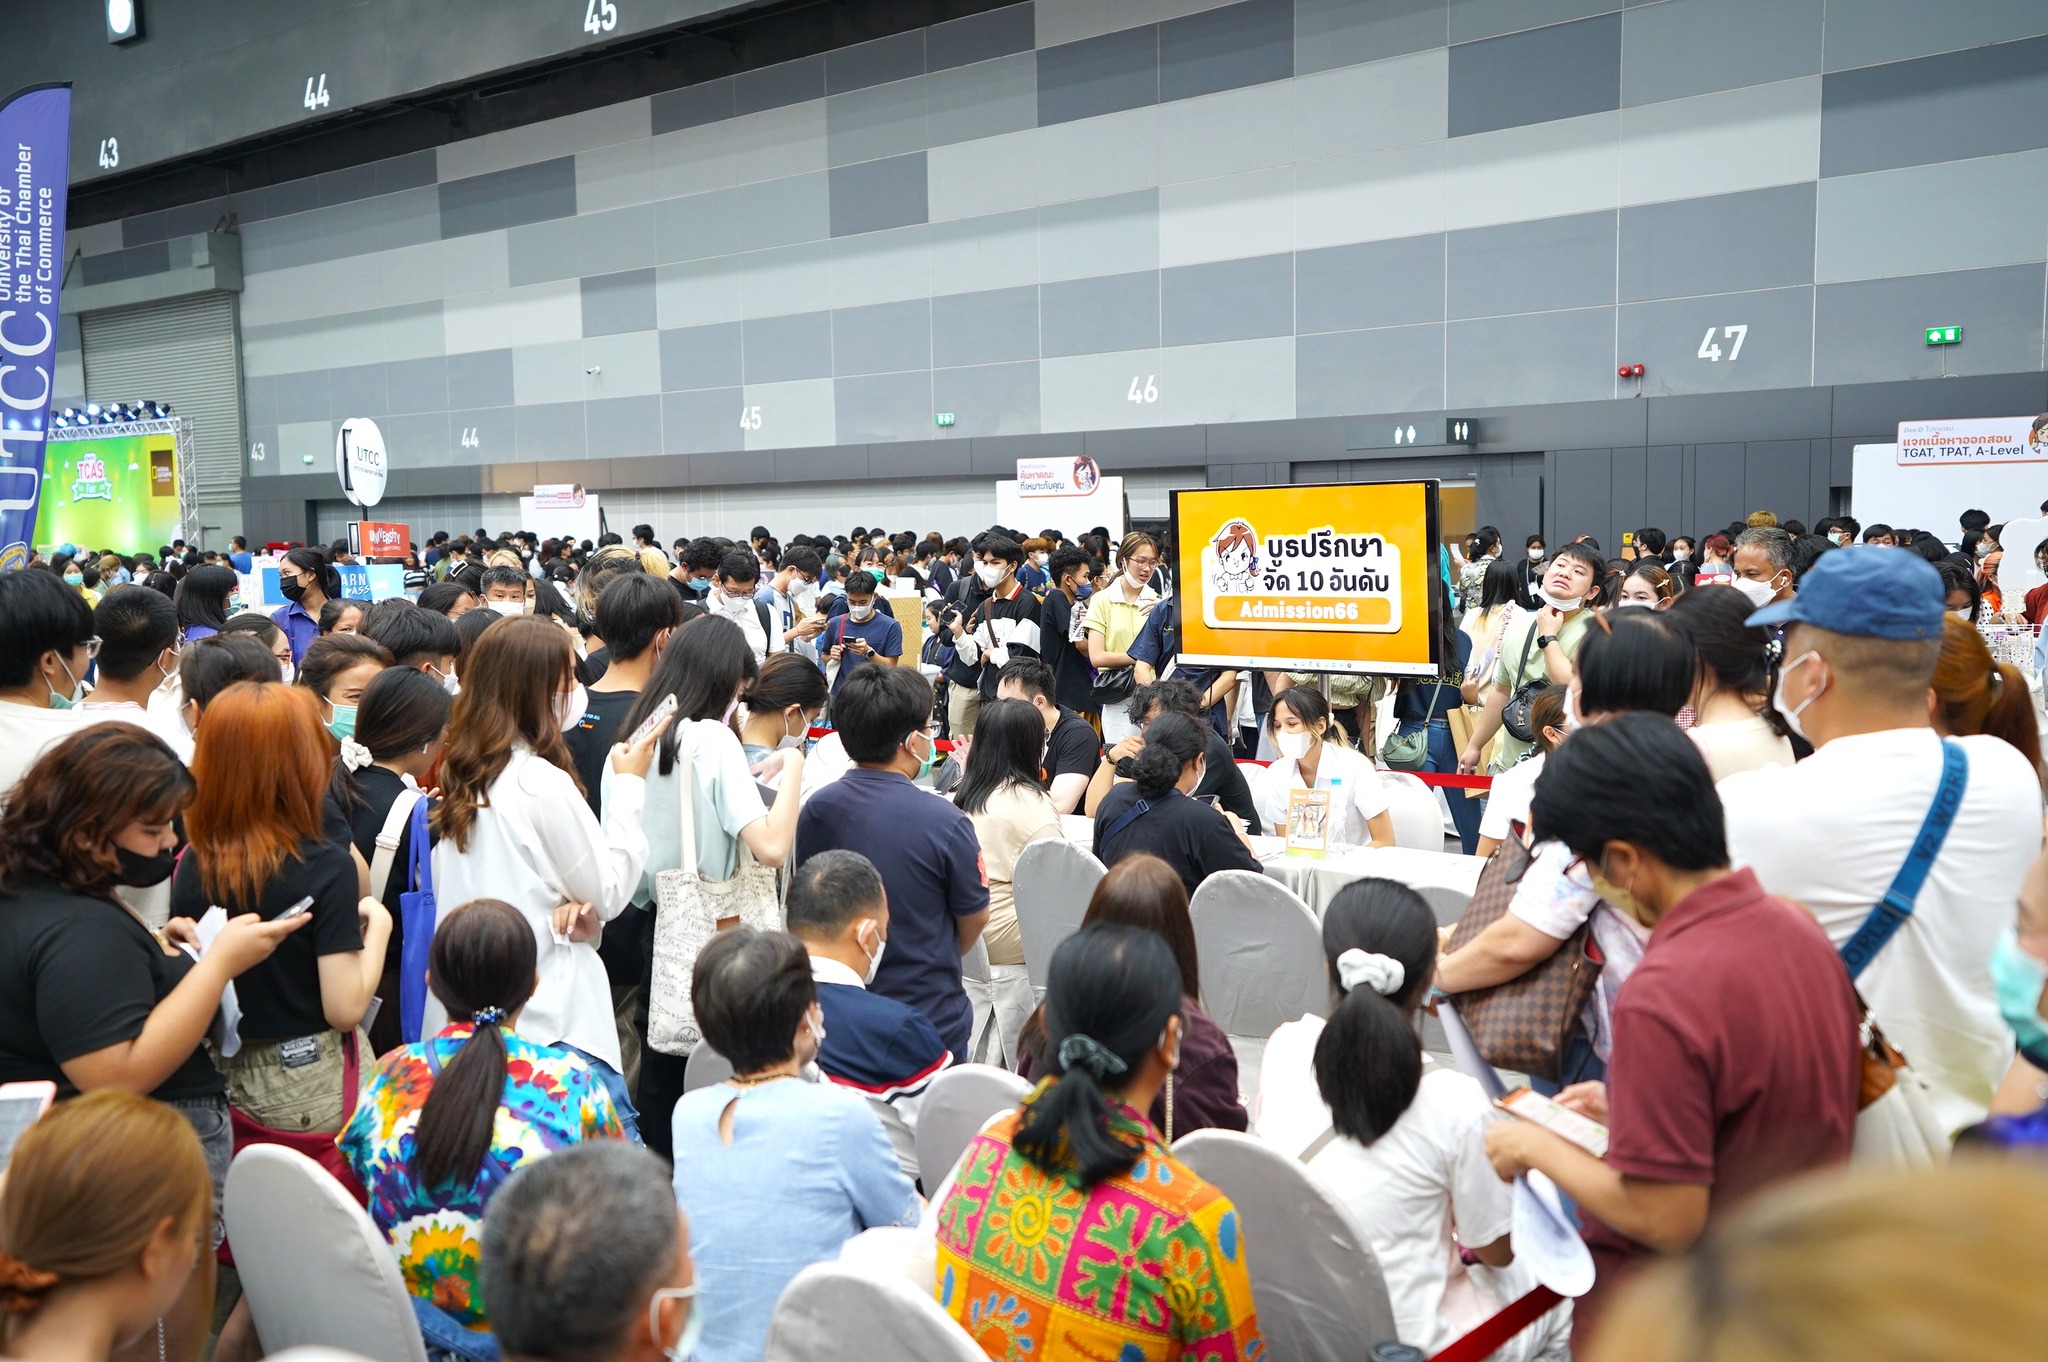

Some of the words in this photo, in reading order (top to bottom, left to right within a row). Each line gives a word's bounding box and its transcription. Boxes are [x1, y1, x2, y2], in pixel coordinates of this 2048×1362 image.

[584, 0, 617, 35] 45
[304, 73, 330, 110] 44
[99, 137, 119, 169] 43
[15, 143, 31, 224] Chamber
[14, 229, 31, 269] Thai
[37, 187, 52, 282] Commerce
[0, 210, 15, 301] University
[15, 273, 31, 303] the
[36, 286, 52, 304] of
[1698, 324, 1748, 361] 47
[1127, 374, 1159, 404] 46
[740, 406, 761, 430] 45
[251, 442, 265, 461] 43
[461, 427, 479, 448] 44
[1903, 432, 2012, 446] แจกเนื้อหาออกสอบ
[1903, 447, 1936, 458] TGAT,
[1940, 446, 1972, 458] TPAT,
[1976, 444, 2024, 456] A-Level
[79, 462, 104, 480] TCAS
[357, 445, 380, 467] UTCC
[1267, 530, 1383, 567] บูธปรึกษา
[341, 573, 366, 586] ARN
[1263, 567, 1291, 591] จัด
[1297, 571, 1324, 591] 10
[1329, 567, 1389, 592] อันดับ
[1240, 600, 1359, 620] Admission66
[1843, 907, 1898, 967] ORLD
